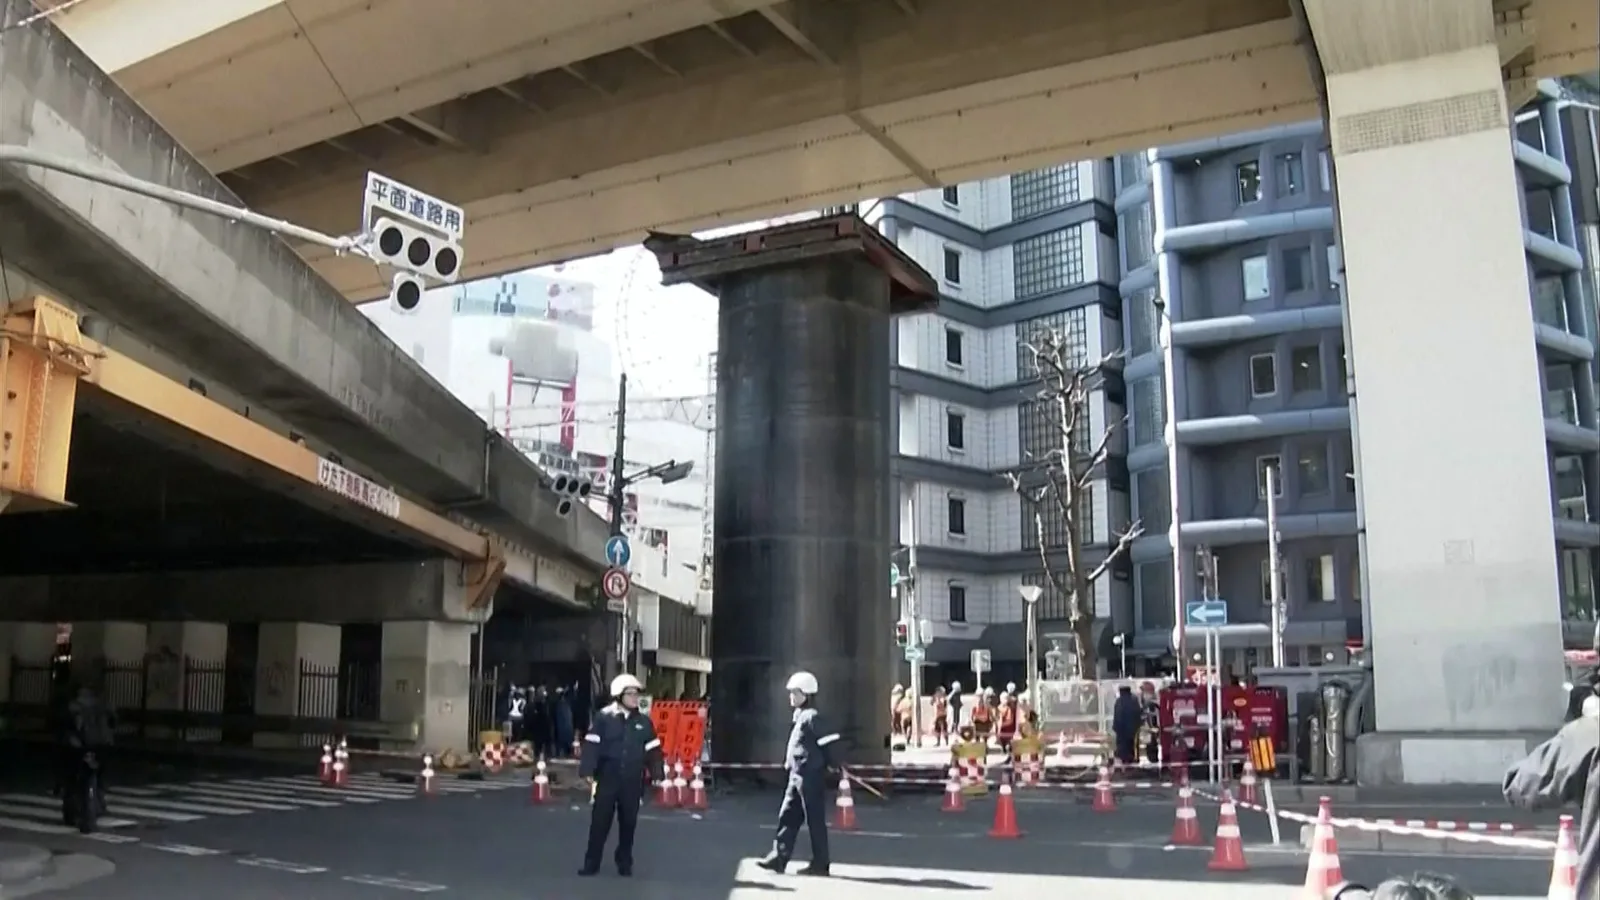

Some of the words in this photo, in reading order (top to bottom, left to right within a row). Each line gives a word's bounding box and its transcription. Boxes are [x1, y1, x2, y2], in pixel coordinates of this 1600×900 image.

[371, 178, 460, 232] 平面道路用
